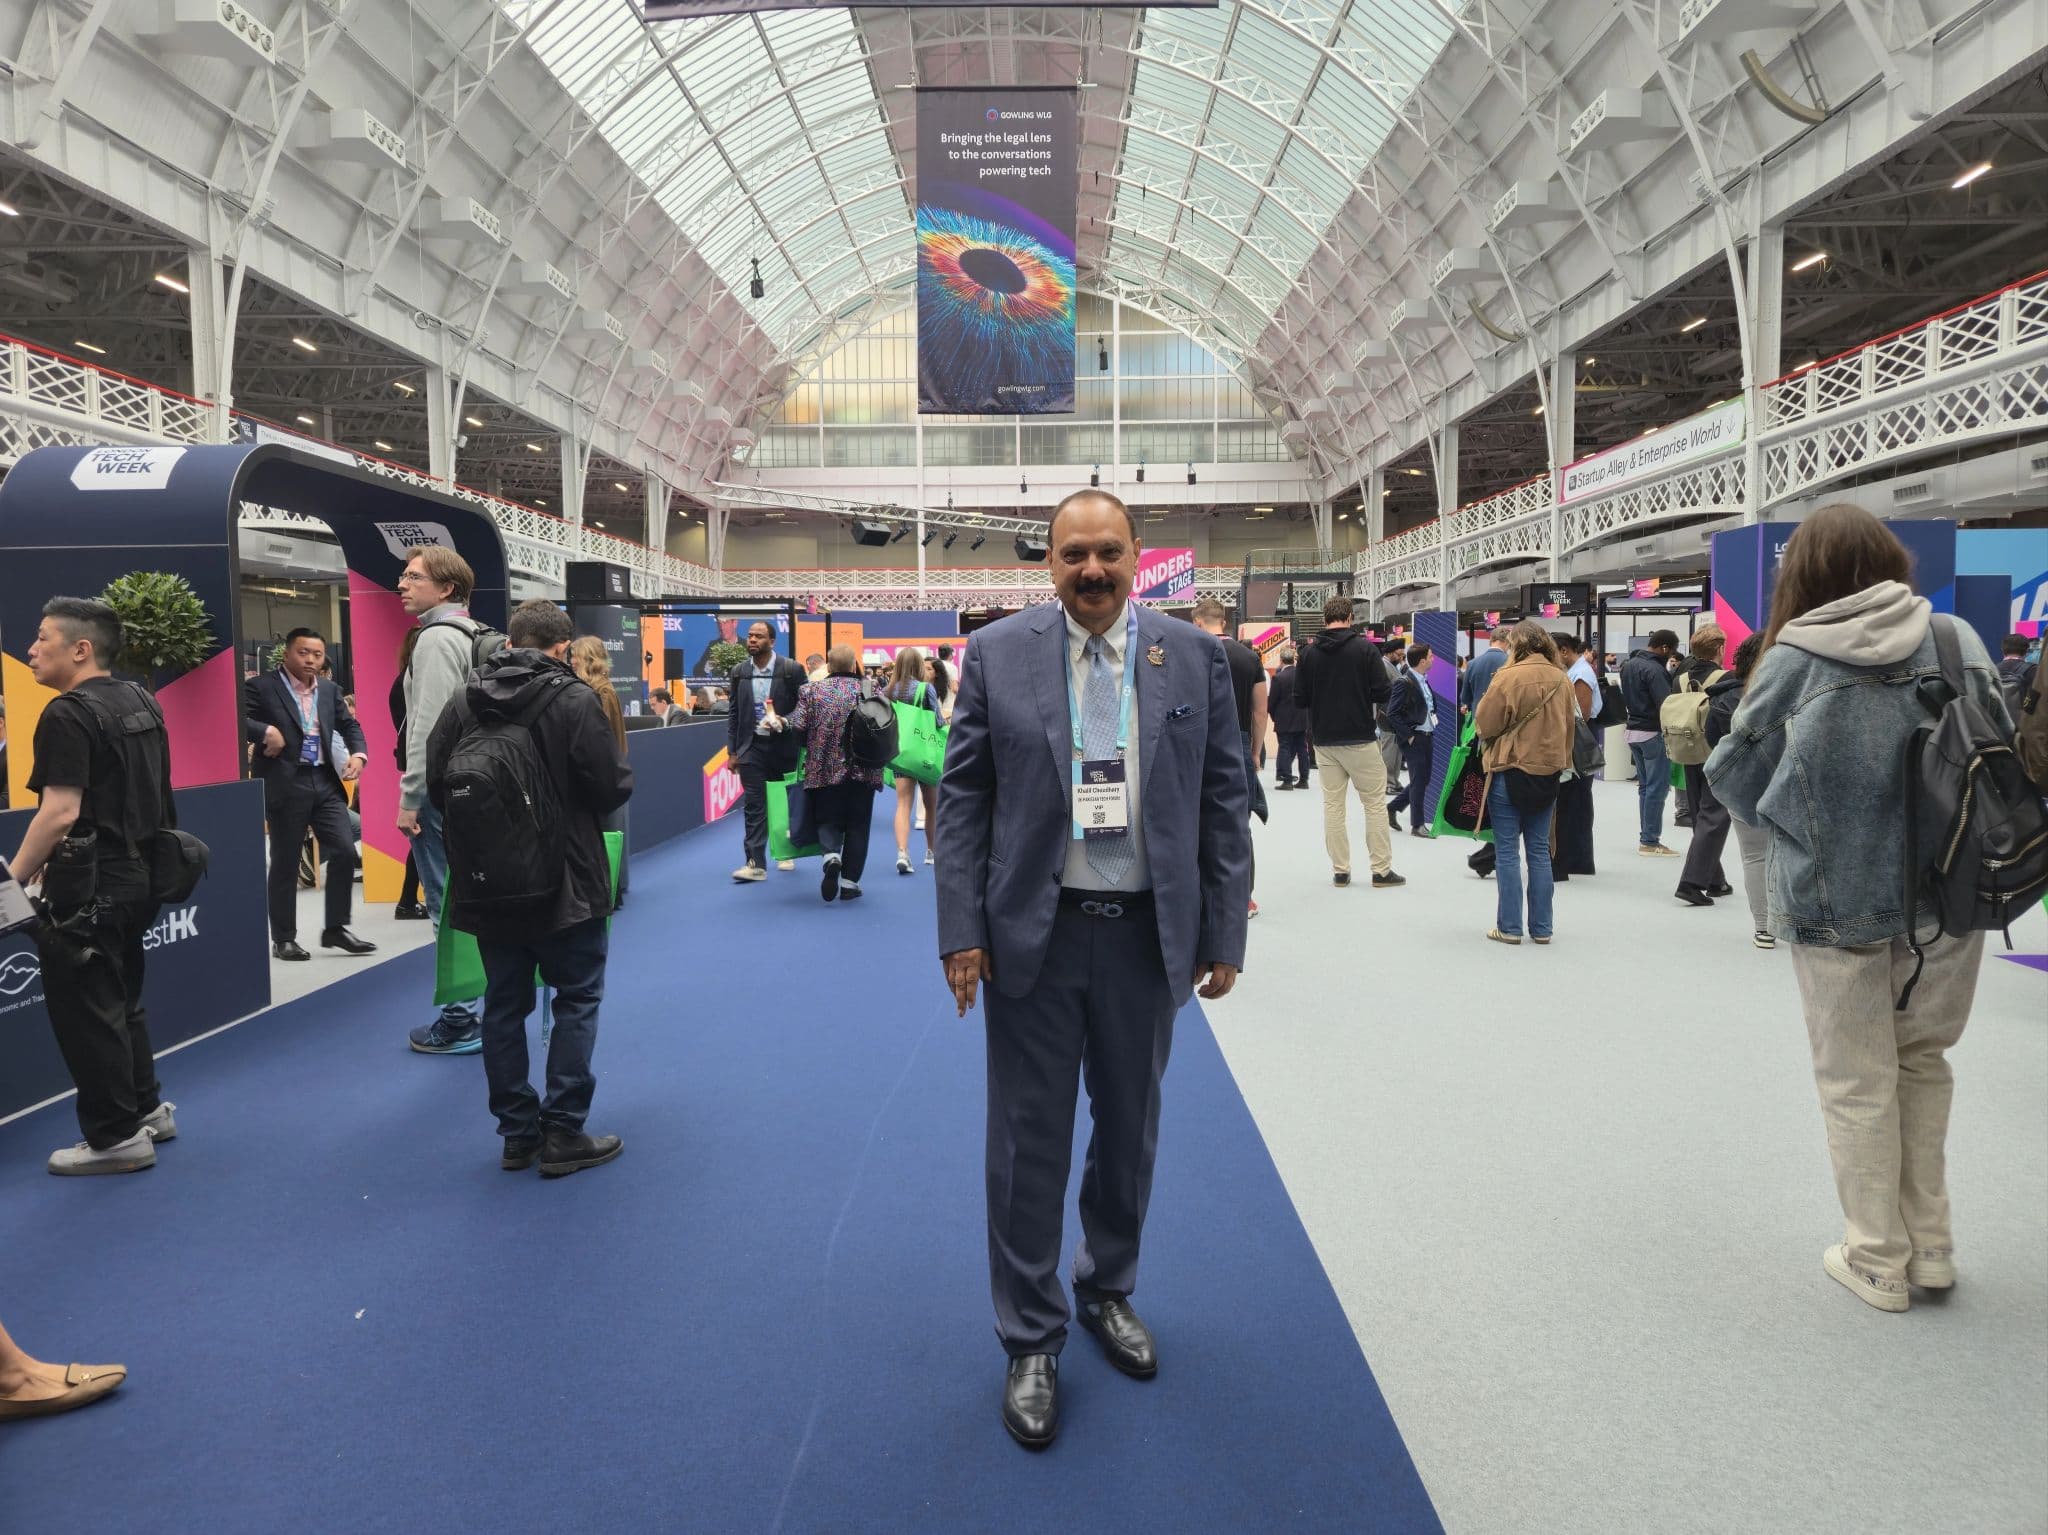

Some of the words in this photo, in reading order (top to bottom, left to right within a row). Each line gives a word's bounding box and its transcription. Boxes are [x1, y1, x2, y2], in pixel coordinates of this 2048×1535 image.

[1000, 111, 1034, 119] GOWLING
[1036, 111, 1052, 119] WLG
[940, 132, 983, 146] Bringing
[984, 132, 1001, 143] the
[1003, 132, 1029, 146] legal
[1030, 132, 1052, 143] lens
[948, 150, 960, 160] to
[962, 149, 979, 160] the
[981, 149, 1052, 160] conversations
[979, 165, 1027, 179] powering
[1029, 165, 1051, 176] tech
[997, 384, 1046, 394] gowlingwlg.com
[91, 453, 146, 462] TECH
[1577, 467, 1606, 488] Startup
[1607, 460, 1628, 478] Alley
[1629, 453, 1637, 470] &
[1638, 437, 1688, 467] Enterprise
[1689, 419, 1722, 447] World
[96, 462, 155, 474] WEEK
[384, 528, 425, 538] TECH
[398, 537, 440, 548] WEEK
[1168, 569, 1193, 596] STAGE
[20, 996, 32, 1006] and
